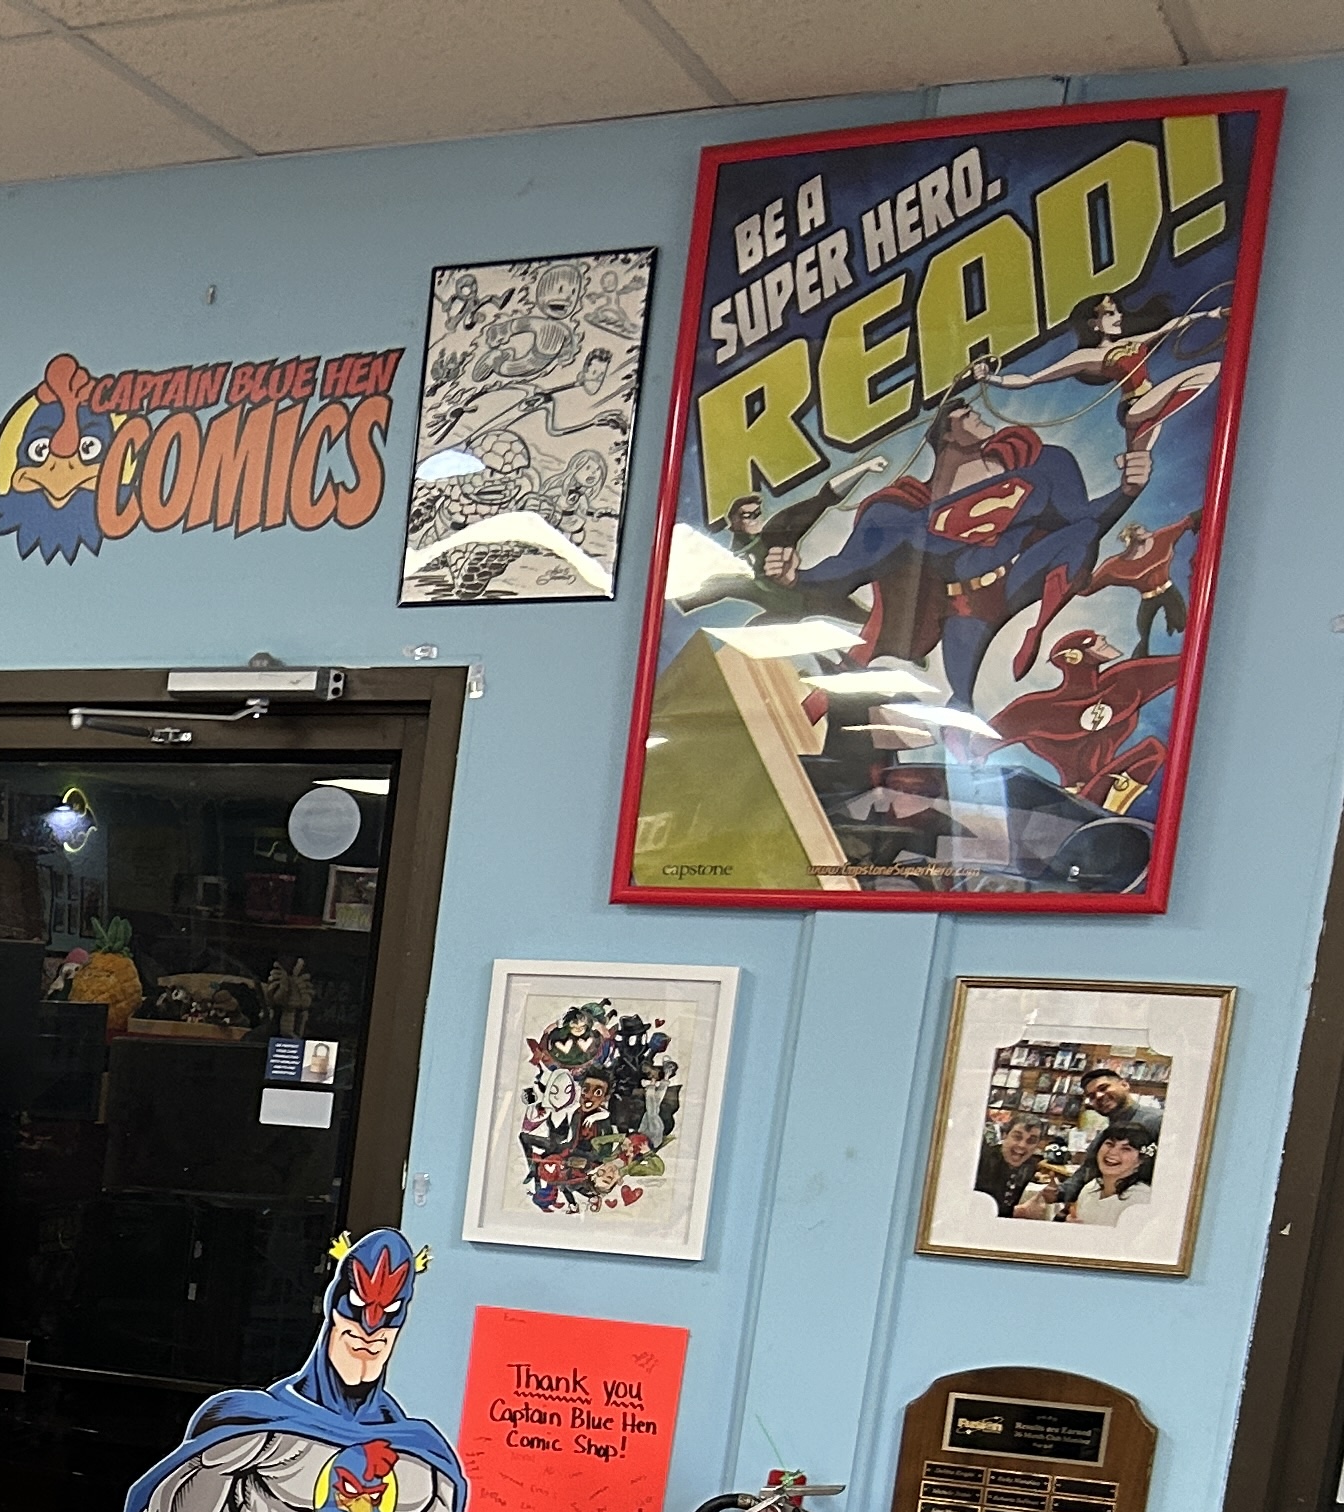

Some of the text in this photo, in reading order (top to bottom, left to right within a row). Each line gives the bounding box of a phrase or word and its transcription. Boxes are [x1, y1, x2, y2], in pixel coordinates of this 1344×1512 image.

[709, 146, 1003, 366] SUPER HERO.
[734, 174, 825, 275] BE A
[696, 113, 1228, 525] READ!
[89, 347, 406, 414] CAPTAIN BLUE HEN
[96, 395, 394, 540] COMICS
[662, 862, 733, 881] capstone
[489, 1398, 657, 1434] Captain Blue Hen
[507, 1364, 642, 1404] Thank you
[506, 1430, 627, 1462] Comic Shop!
